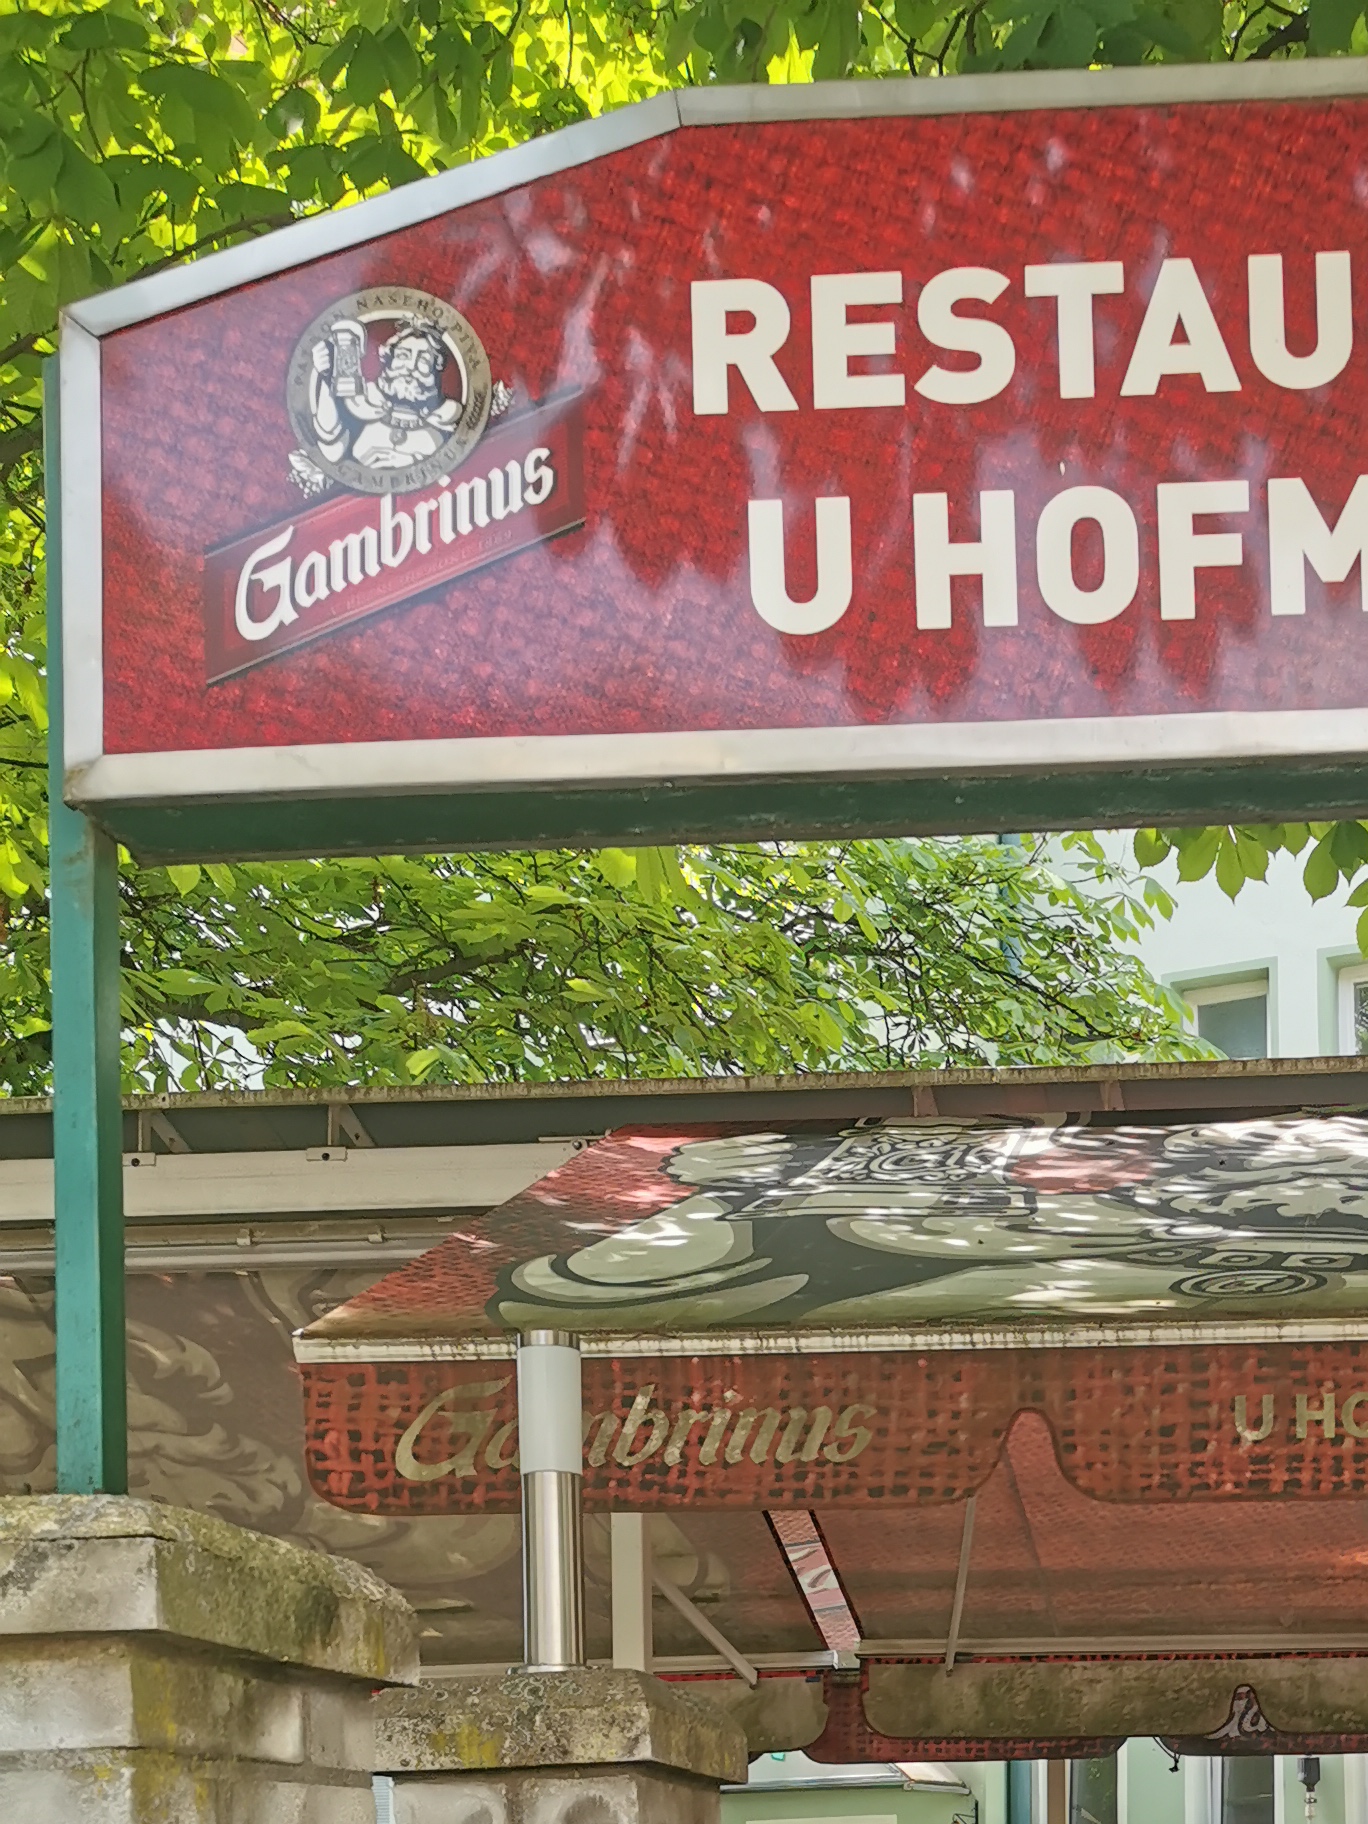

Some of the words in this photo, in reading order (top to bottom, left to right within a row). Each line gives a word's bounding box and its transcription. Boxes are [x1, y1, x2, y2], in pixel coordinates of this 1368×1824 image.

[235, 447, 554, 641] Gambrinus
[748, 497, 852, 634] U
[1234, 1393, 1275, 1442] U
